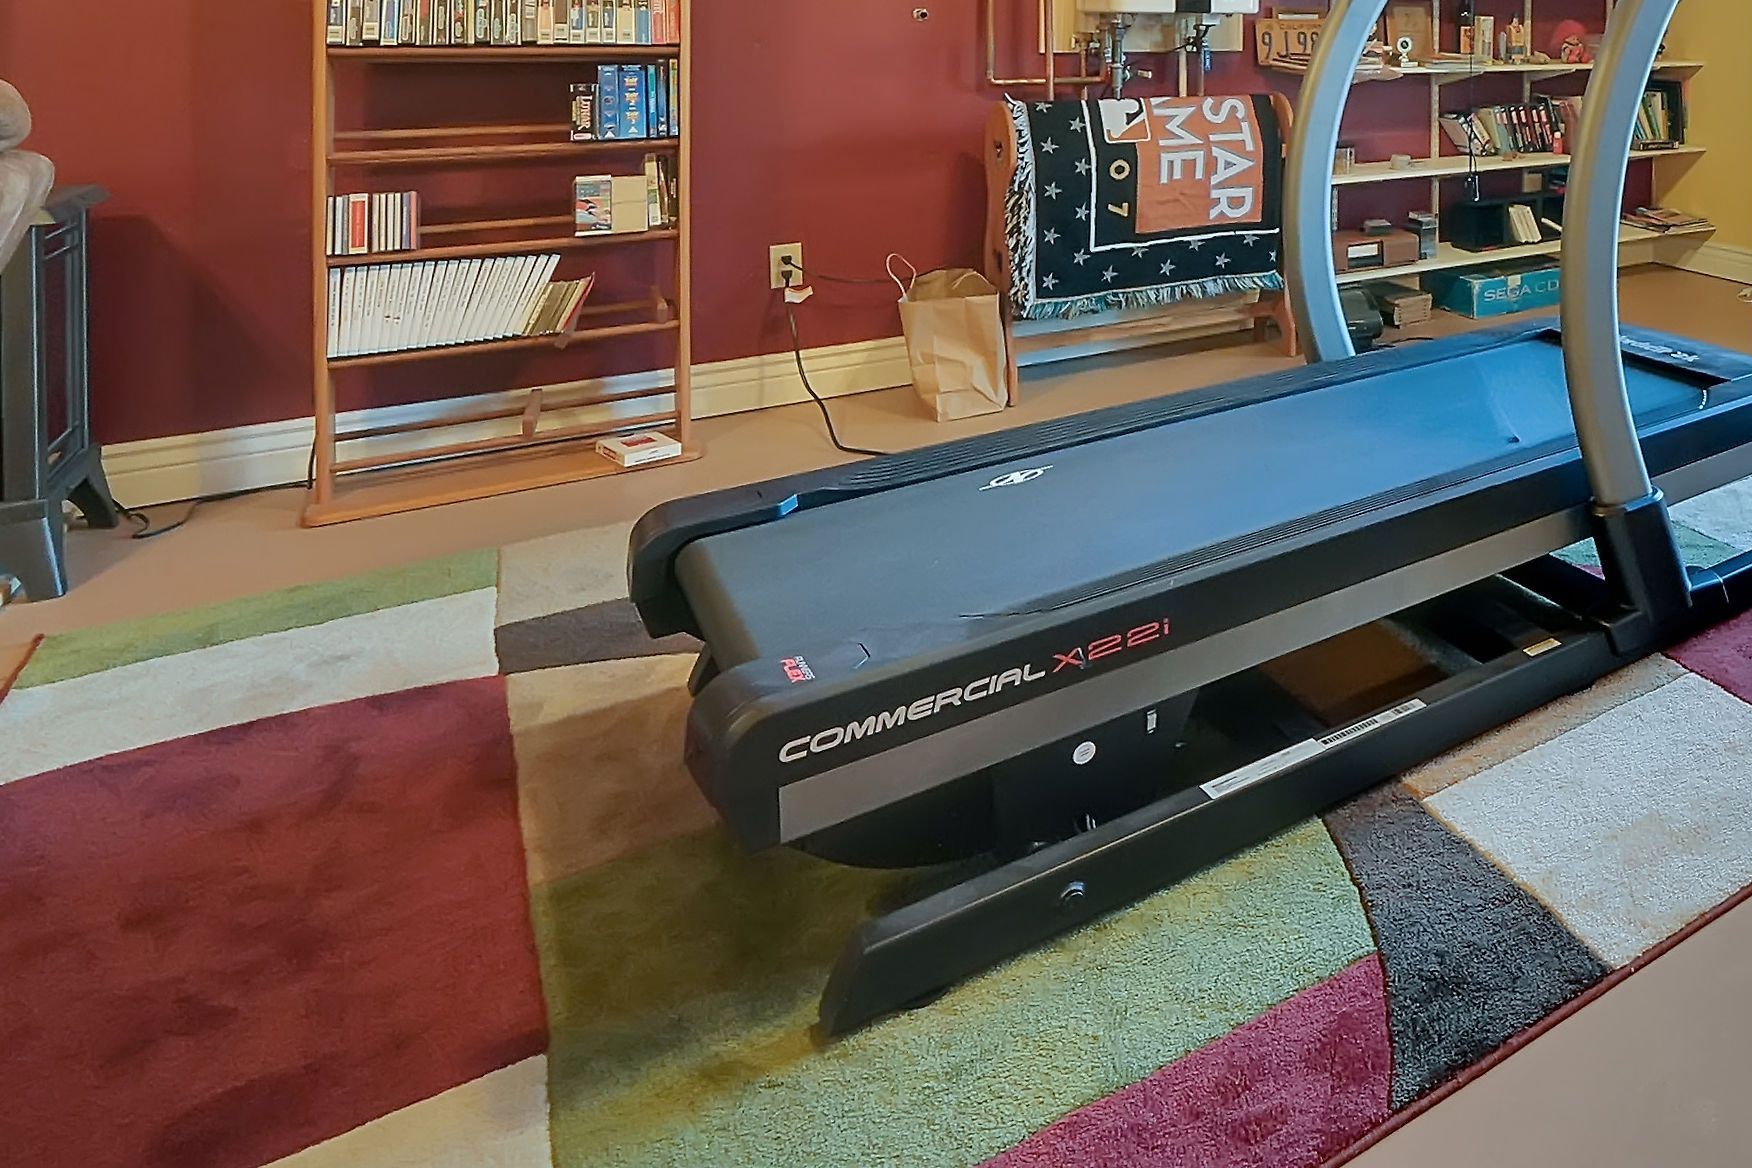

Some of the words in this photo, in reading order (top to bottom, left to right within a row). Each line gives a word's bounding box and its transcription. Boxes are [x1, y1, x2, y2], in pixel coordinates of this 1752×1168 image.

[1261, 31, 1273, 60] 9
[1201, 96, 1255, 221] STAR
[1483, 284, 1532, 302] SEGA
[1535, 278, 1560, 293] CD
[778, 661, 1046, 764] COMMERCIAL
[1051, 616, 1171, 673] X22i
